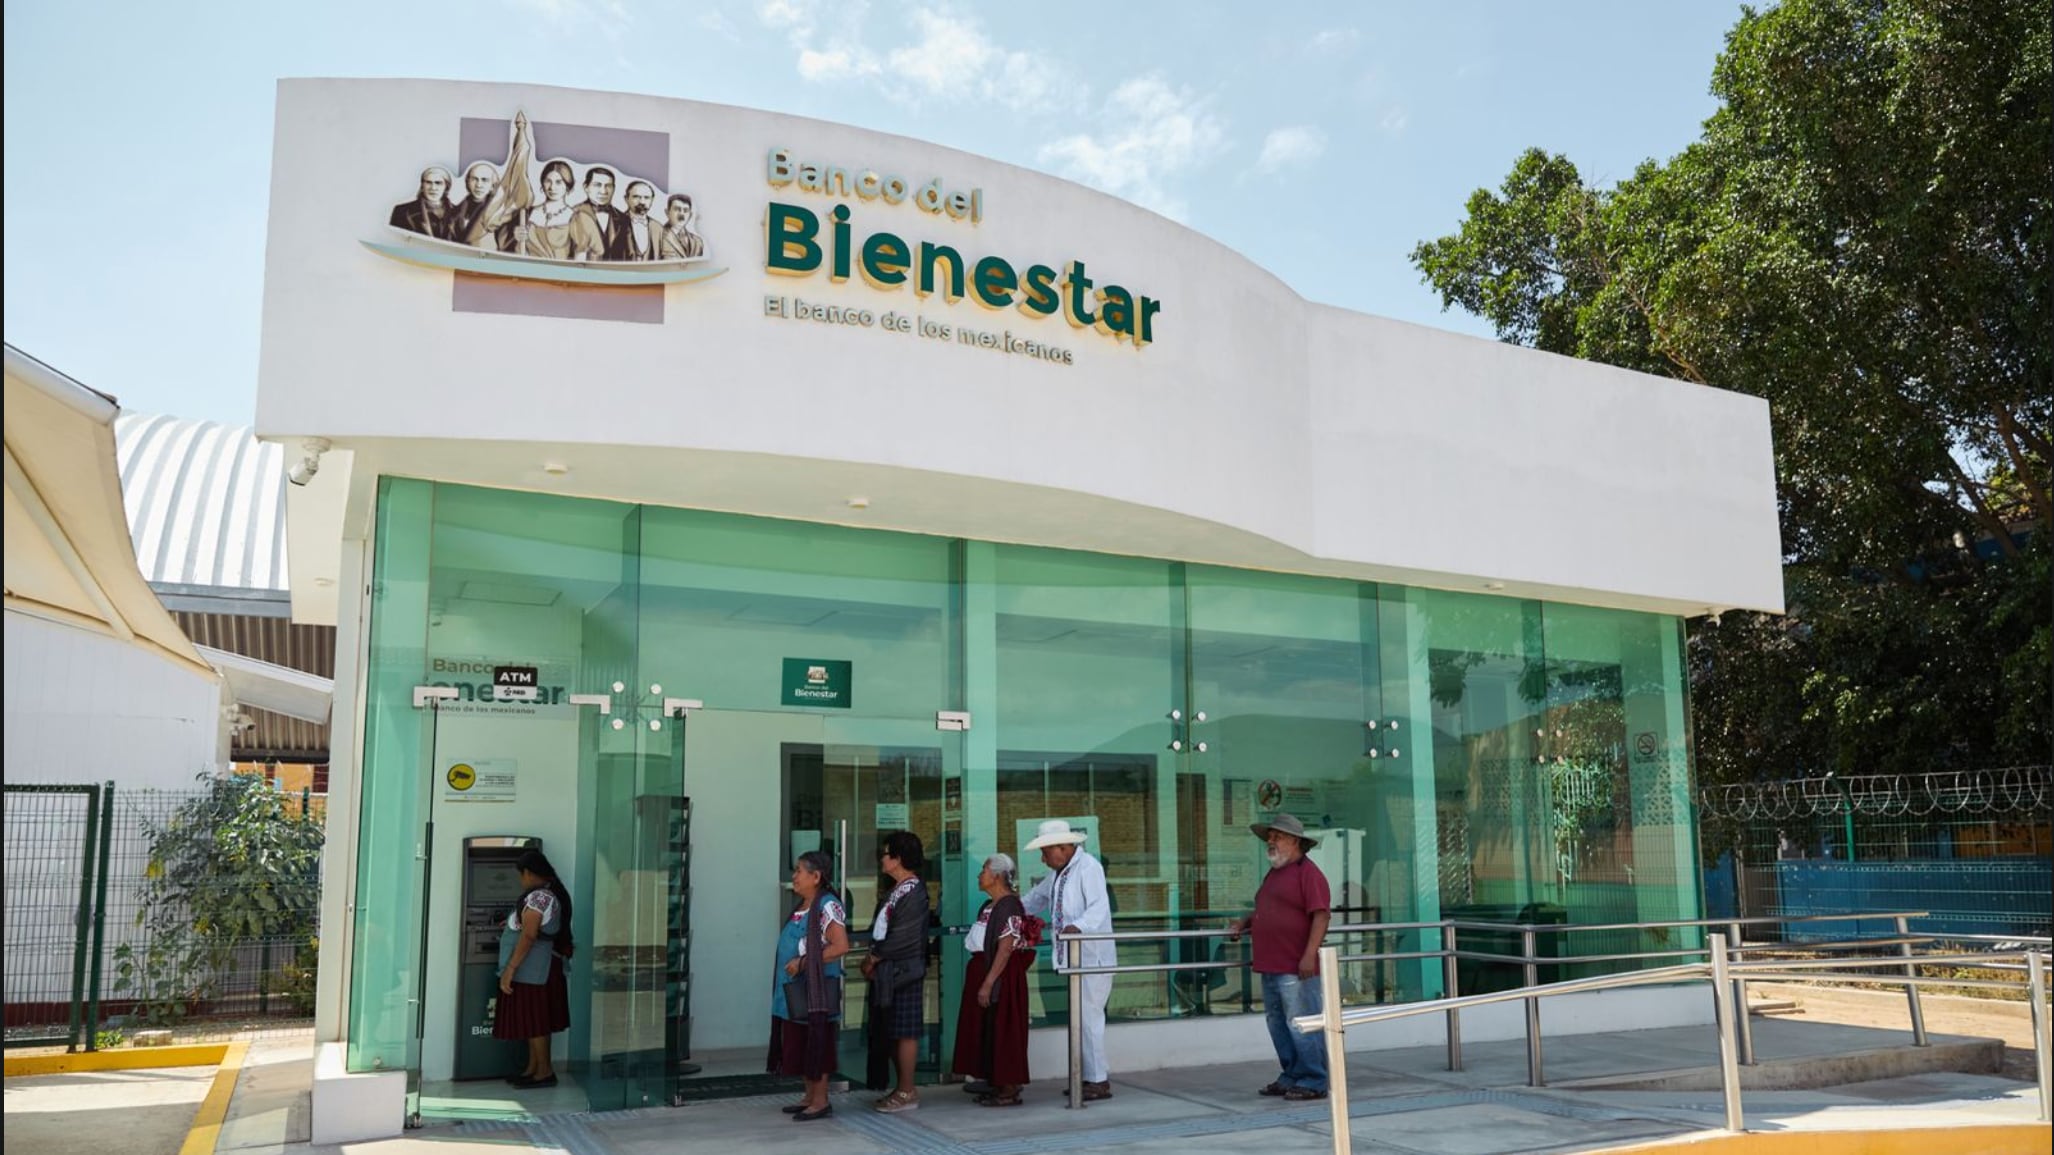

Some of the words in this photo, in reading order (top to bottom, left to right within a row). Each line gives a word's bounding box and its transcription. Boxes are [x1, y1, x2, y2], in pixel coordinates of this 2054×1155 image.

[767, 147, 909, 205] Banco
[916, 176, 983, 224] del
[766, 201, 1161, 348] Bienestar
[764, 295, 789, 319] El
[794, 297, 875, 327] banco
[880, 310, 912, 333] de
[917, 315, 951, 341] los
[957, 326, 1074, 366] mexicanos
[433, 658, 495, 674] Banco
[499, 671, 532, 683] ATM
[794, 688, 838, 699] Bienestar
